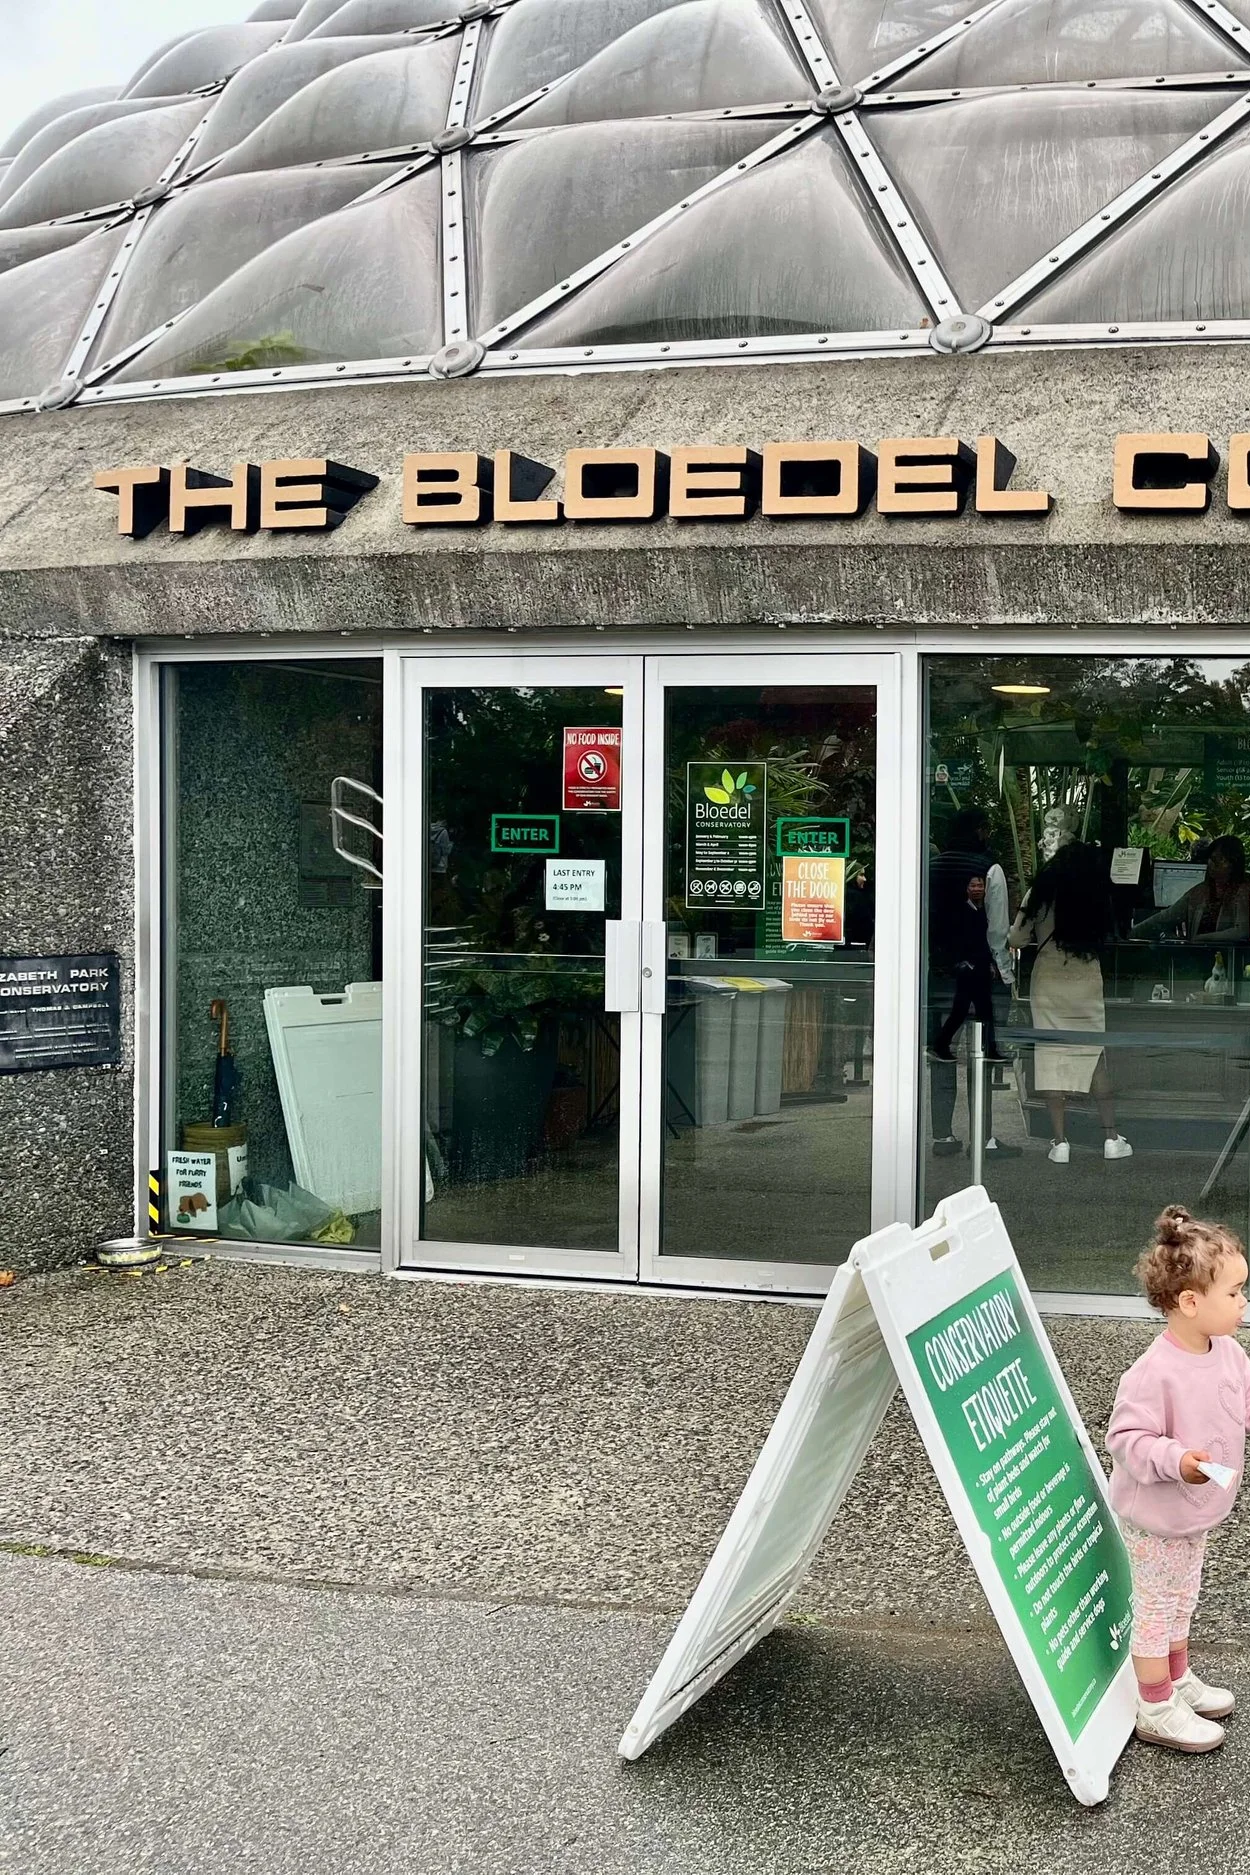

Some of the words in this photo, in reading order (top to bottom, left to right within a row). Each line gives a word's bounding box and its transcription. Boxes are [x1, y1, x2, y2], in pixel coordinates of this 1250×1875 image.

[94, 458, 330, 537] THE
[402, 435, 1051, 526] BLOEDEL
[567, 733, 577, 745] NO
[578, 733, 597, 745] FOOD
[597, 733, 620, 746] INSIDE
[695, 802, 751, 819] Bloedel
[501, 827, 550, 841] ENTER
[788, 831, 839, 845] ENTER
[553, 869, 571, 877] LAST
[572, 869, 595, 877] ENTRY
[797, 862, 830, 880] CLOSE
[552, 883, 568, 891] 4:45
[570, 883, 582, 891] PM
[786, 880, 808, 899] THE
[809, 881, 838, 899] DOOR
[70, 968, 109, 979] PARK
[0, 982, 109, 997] ONSERVATORY
[172, 1156, 190, 1164] FRESH
[191, 1157, 212, 1165] WATER
[176, 1168, 187, 1176] FOR
[188, 1168, 207, 1177] FURRY
[178, 1180, 202, 1189] FRIENDS
[924, 1288, 1021, 1392] CONSERVATORY
[961, 1357, 1038, 1453] ETIQUETTE
[979, 1468, 995, 1487] Stay
[992, 1461, 1002, 1475] on
[999, 1438, 1027, 1471] pathways.
[1023, 1423, 1041, 1444] Please
[1038, 1414, 1051, 1430] stay
[1047, 1406, 1057, 1420] out
[986, 1486, 997, 1503] of
[992, 1475, 1009, 1501] plant
[1005, 1464, 1021, 1483] beds
[1018, 1453, 1031, 1472] and
[1027, 1440, 1045, 1462] watch
[1041, 1434, 1051, 1450] for
[993, 1495, 1010, 1521] small
[1006, 1485, 1023, 1506] birds
[1001, 1525, 1013, 1541] No
[1010, 1505, 1031, 1532] outside
[1027, 1491, 1042, 1515] food
[1039, 1487, 1047, 1500] or
[1043, 1466, 1067, 1495] beverage
[1062, 1461, 1071, 1474] is
[1009, 1521, 1036, 1561] permitted
[1032, 1504, 1054, 1530] indoors
[1017, 1553, 1037, 1578] Please
[1032, 1538, 1049, 1560] leave
[1046, 1527, 1058, 1544] any
[1055, 1511, 1072, 1537] plants
[1069, 1505, 1077, 1518] or
[1025, 1562, 1049, 1595] outdoors
[1046, 1555, 1055, 1569] to
[1052, 1535, 1071, 1565] protect
[1068, 1525, 1079, 1542] our
[1076, 1501, 1099, 1532] ecosystem
[1032, 1600, 1043, 1616] Do
[1041, 1587, 1053, 1606] not
[1049, 1571, 1066, 1594] touch
[1062, 1561, 1074, 1578] the
[1070, 1547, 1085, 1568] birds
[1081, 1541, 1089, 1554] or
[1086, 1520, 1104, 1548] tropical
[1040, 1606, 1058, 1635] plants
[1048, 1637, 1059, 1653] No
[1056, 1622, 1070, 1646] pets
[1066, 1605, 1081, 1629] other
[1078, 1591, 1092, 1612] than
[1088, 1569, 1109, 1598] working
[1056, 1645, 1073, 1673] guide
[1069, 1630, 1081, 1652] and
[1078, 1611, 1096, 1639] service
[1093, 1597, 1106, 1617] dogs
